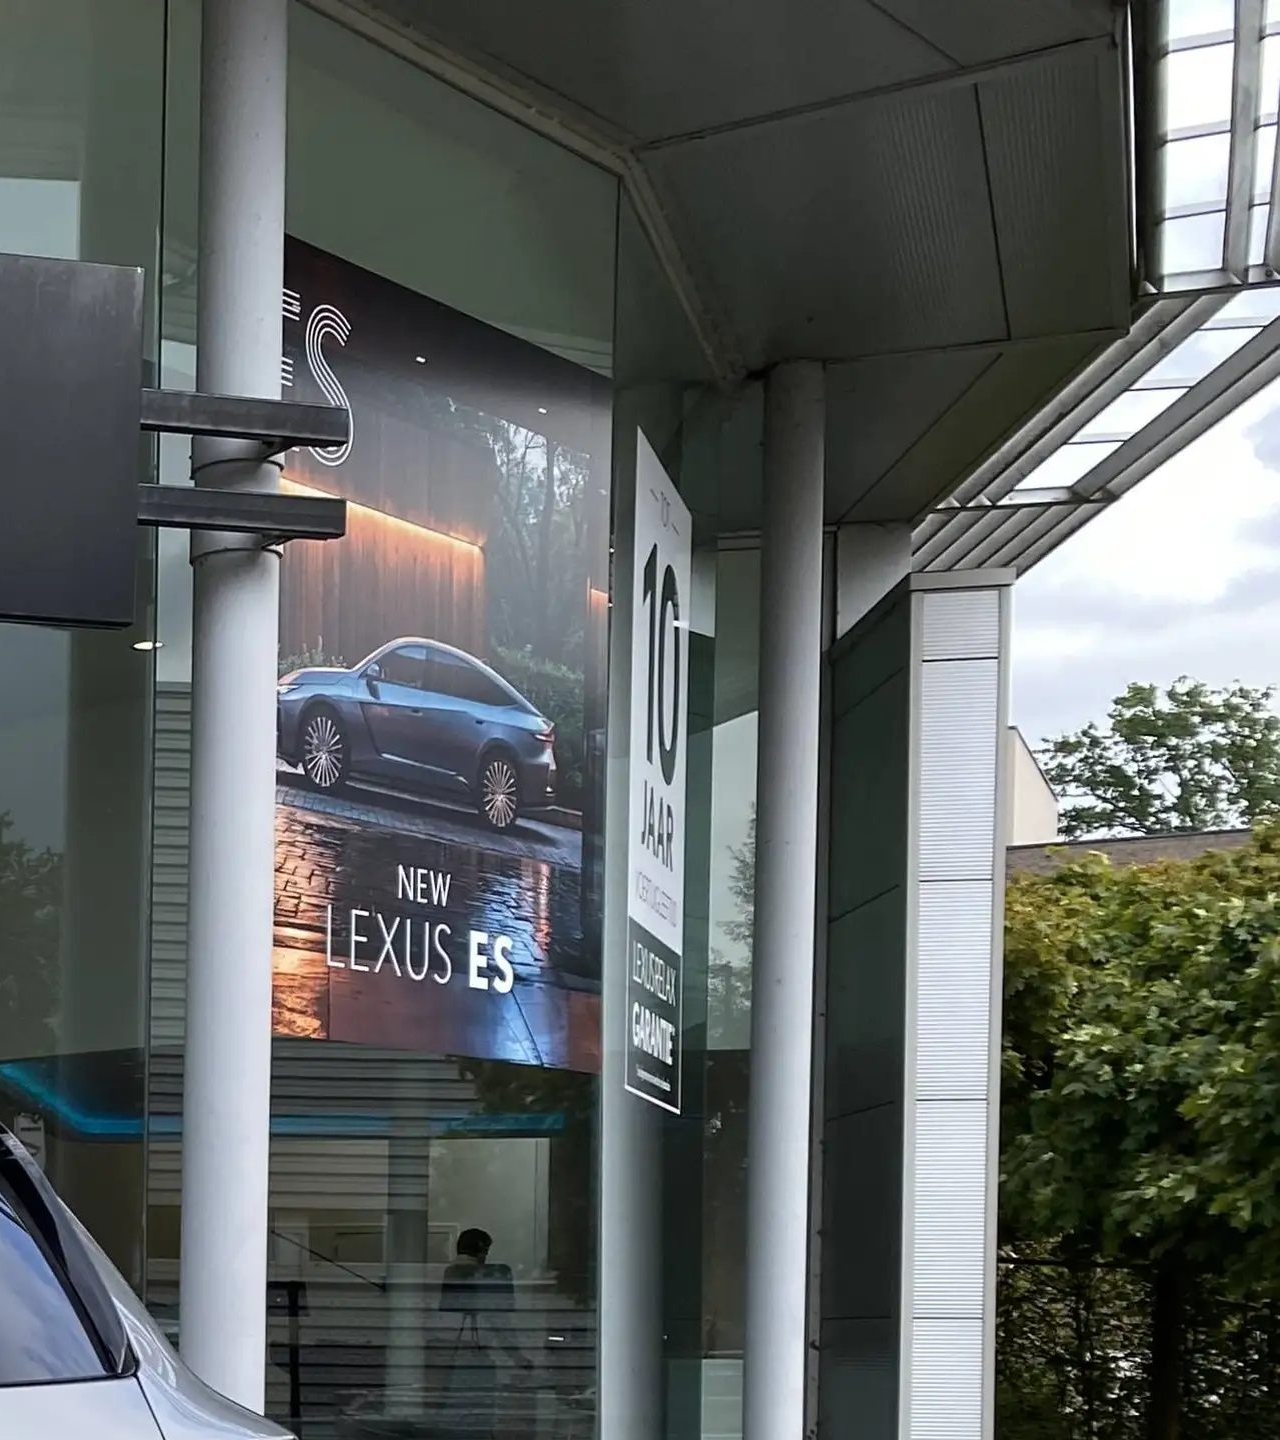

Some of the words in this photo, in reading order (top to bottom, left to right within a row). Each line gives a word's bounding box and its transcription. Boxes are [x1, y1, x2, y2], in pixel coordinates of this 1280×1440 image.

[642, 543, 680, 786] 10
[641, 779, 674, 873] JAAR
[397, 864, 451, 907] NEW
[326, 904, 452, 985] LEXUS
[469, 929, 514, 994] ES
